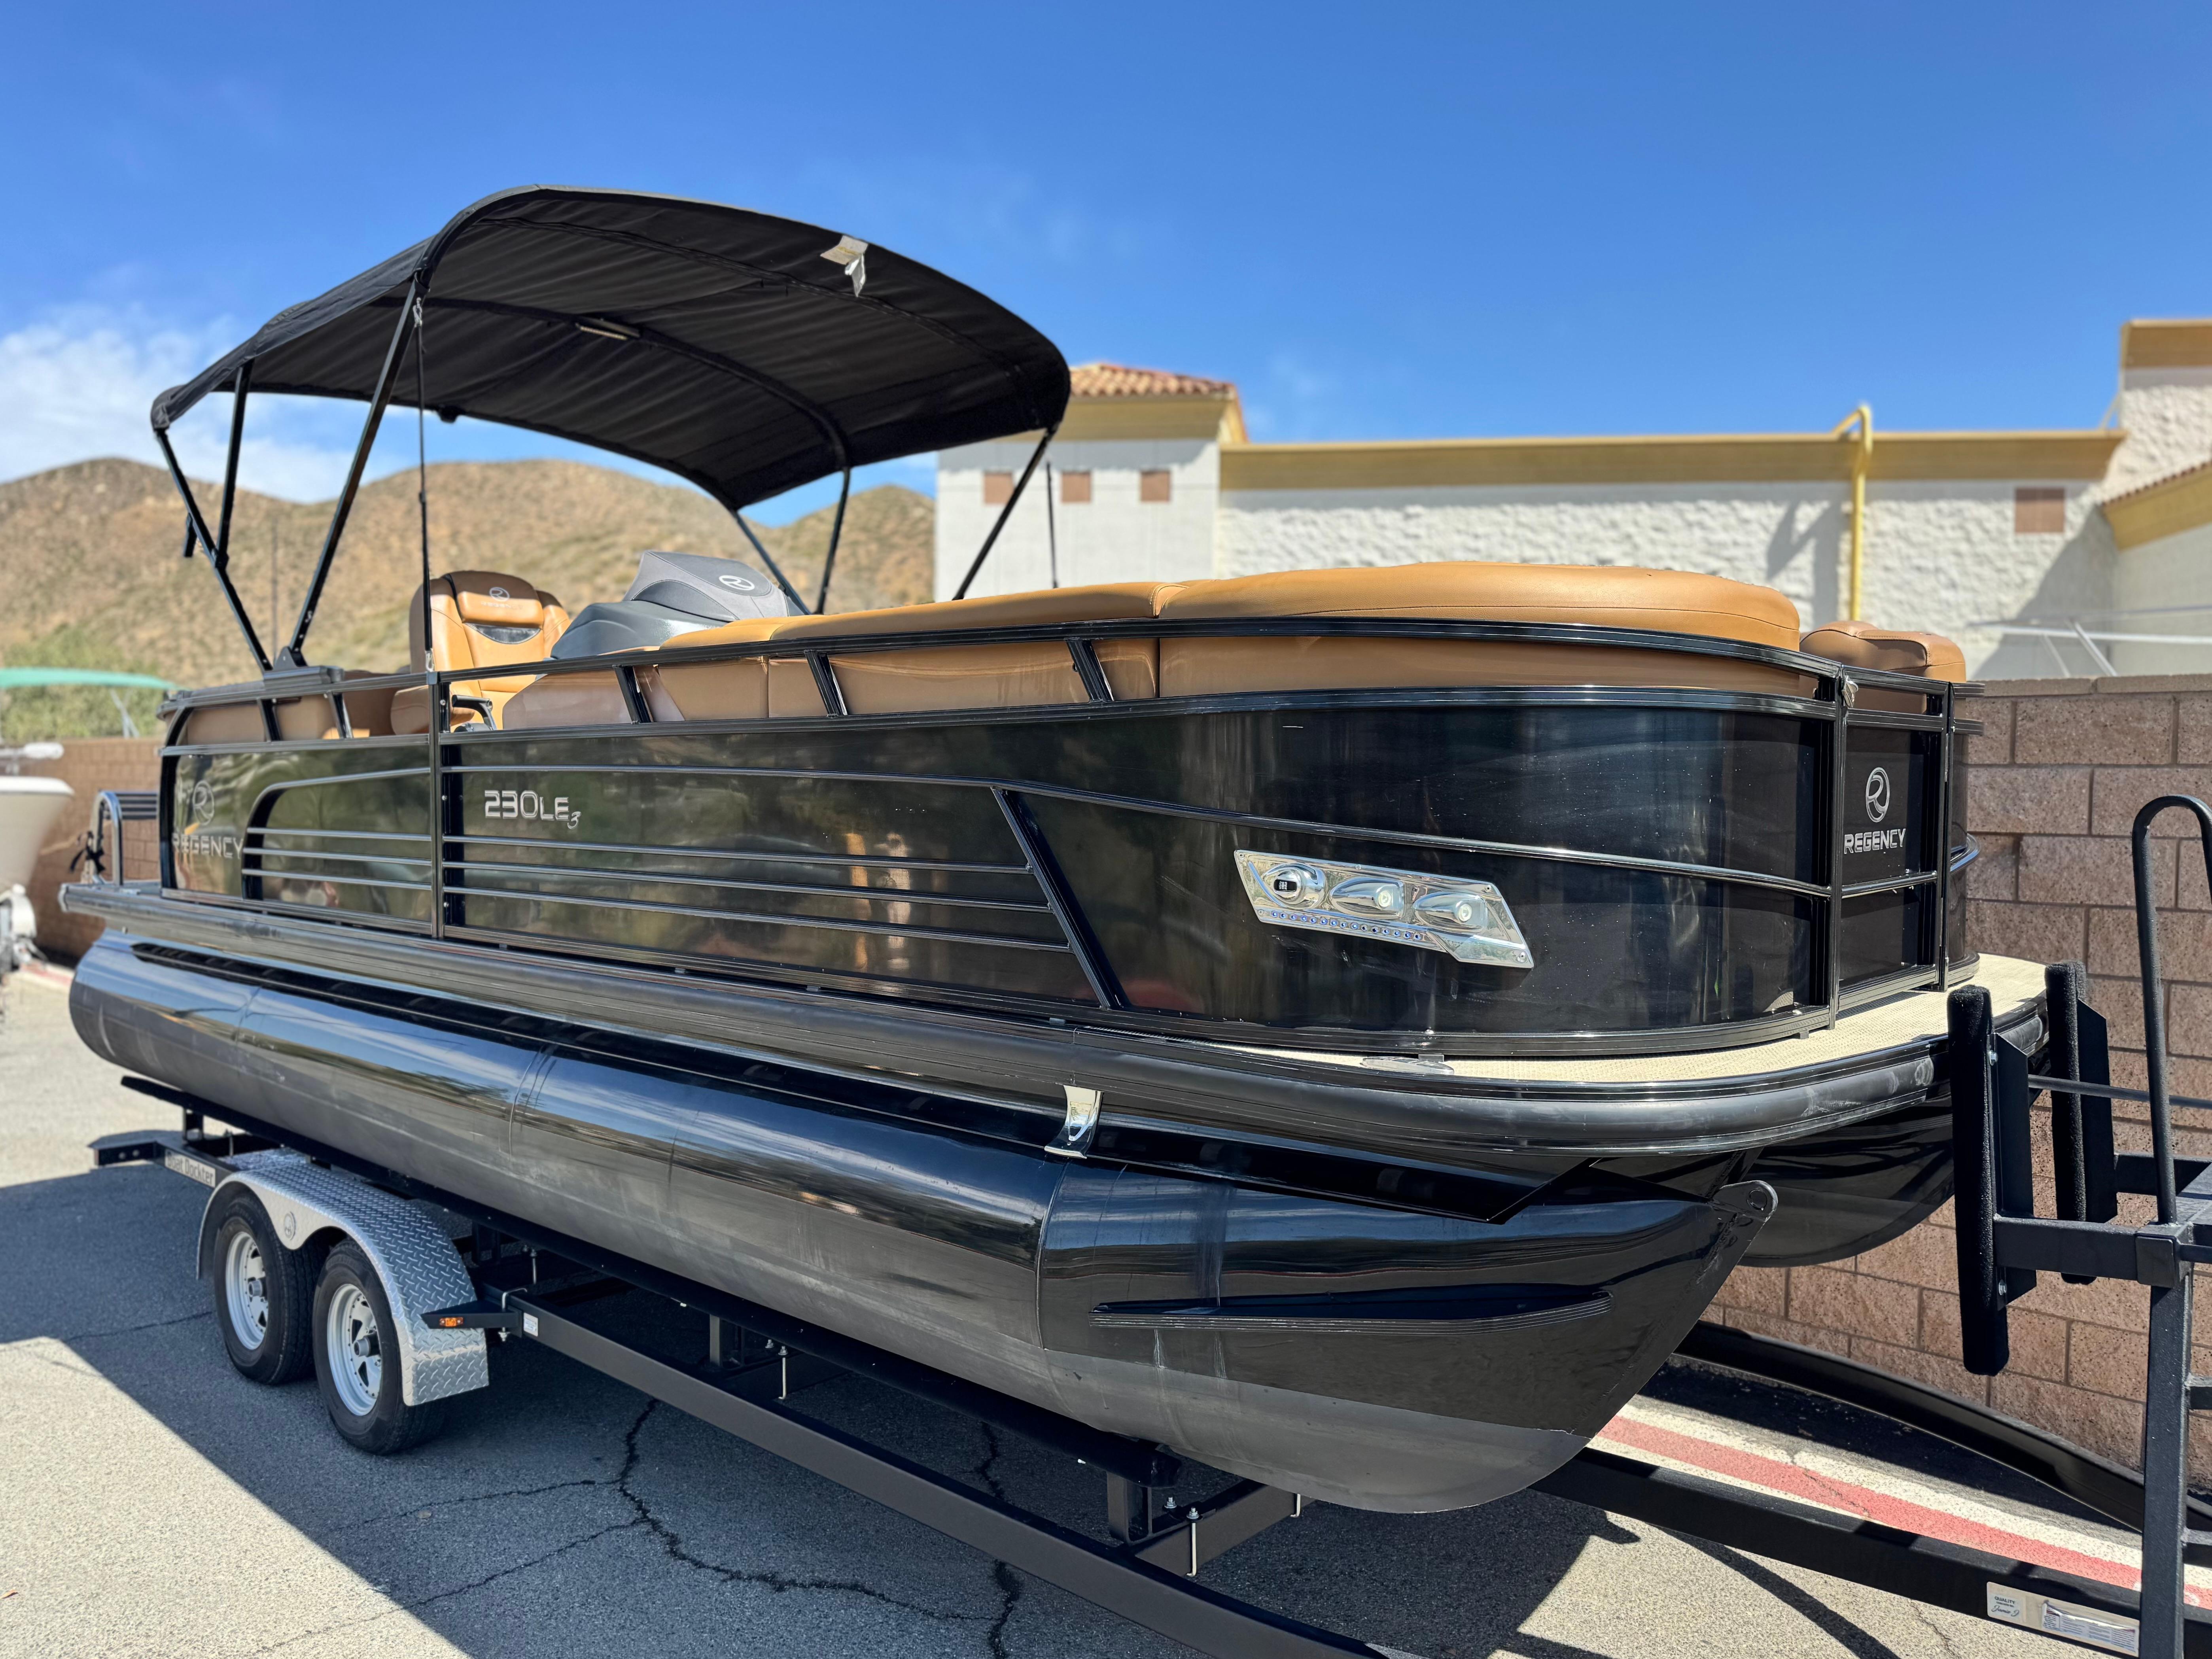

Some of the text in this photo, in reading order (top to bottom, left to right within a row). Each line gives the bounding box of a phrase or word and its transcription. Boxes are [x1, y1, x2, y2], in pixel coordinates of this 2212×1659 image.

[172, 832, 244, 859] REGENCY
[1844, 828, 1906, 854] REGENCY
[167, 1151, 214, 1185] Boat Dockter
